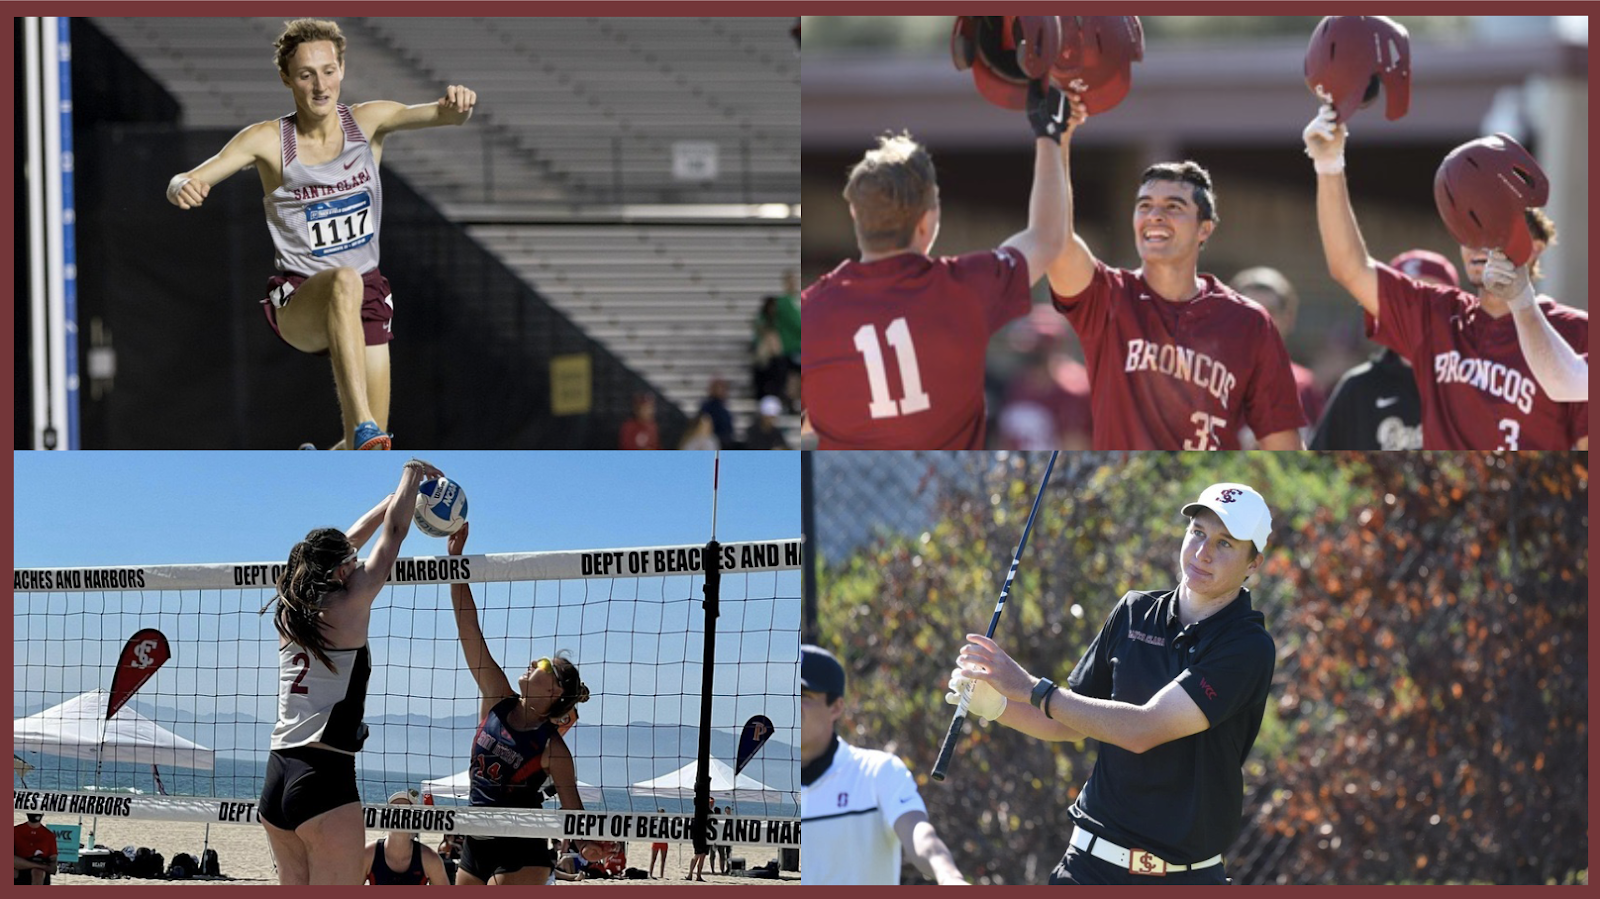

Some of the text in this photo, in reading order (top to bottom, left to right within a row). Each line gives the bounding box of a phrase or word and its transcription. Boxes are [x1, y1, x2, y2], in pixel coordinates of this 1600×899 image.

[293, 184, 335, 200] SANTA
[311, 208, 369, 248] 1117
[853, 317, 931, 419] 11
[1125, 339, 1237, 409] BRONCOS
[1434, 350, 1537, 414] BRONCOS
[396, 558, 471, 582] HARBORS
[581, 552, 624, 576] DEPT
[628, 551, 649, 574] OF
[741, 543, 779, 569] AND
[785, 542, 801, 566] H
[14, 568, 145, 590] ACHES AND HARBORS
[234, 564, 287, 586] DEPT O
[290, 652, 310, 695] 2
[40, 792, 67, 813] AND
[69, 794, 132, 817] HARBORS
[218, 801, 255, 822] DEPT
[380, 807, 456, 831] HARBORS
[564, 813, 607, 837] DEPT
[610, 814, 633, 838] OF
[636, 815, 718, 841] BEACHS
[722, 818, 761, 843] AND
